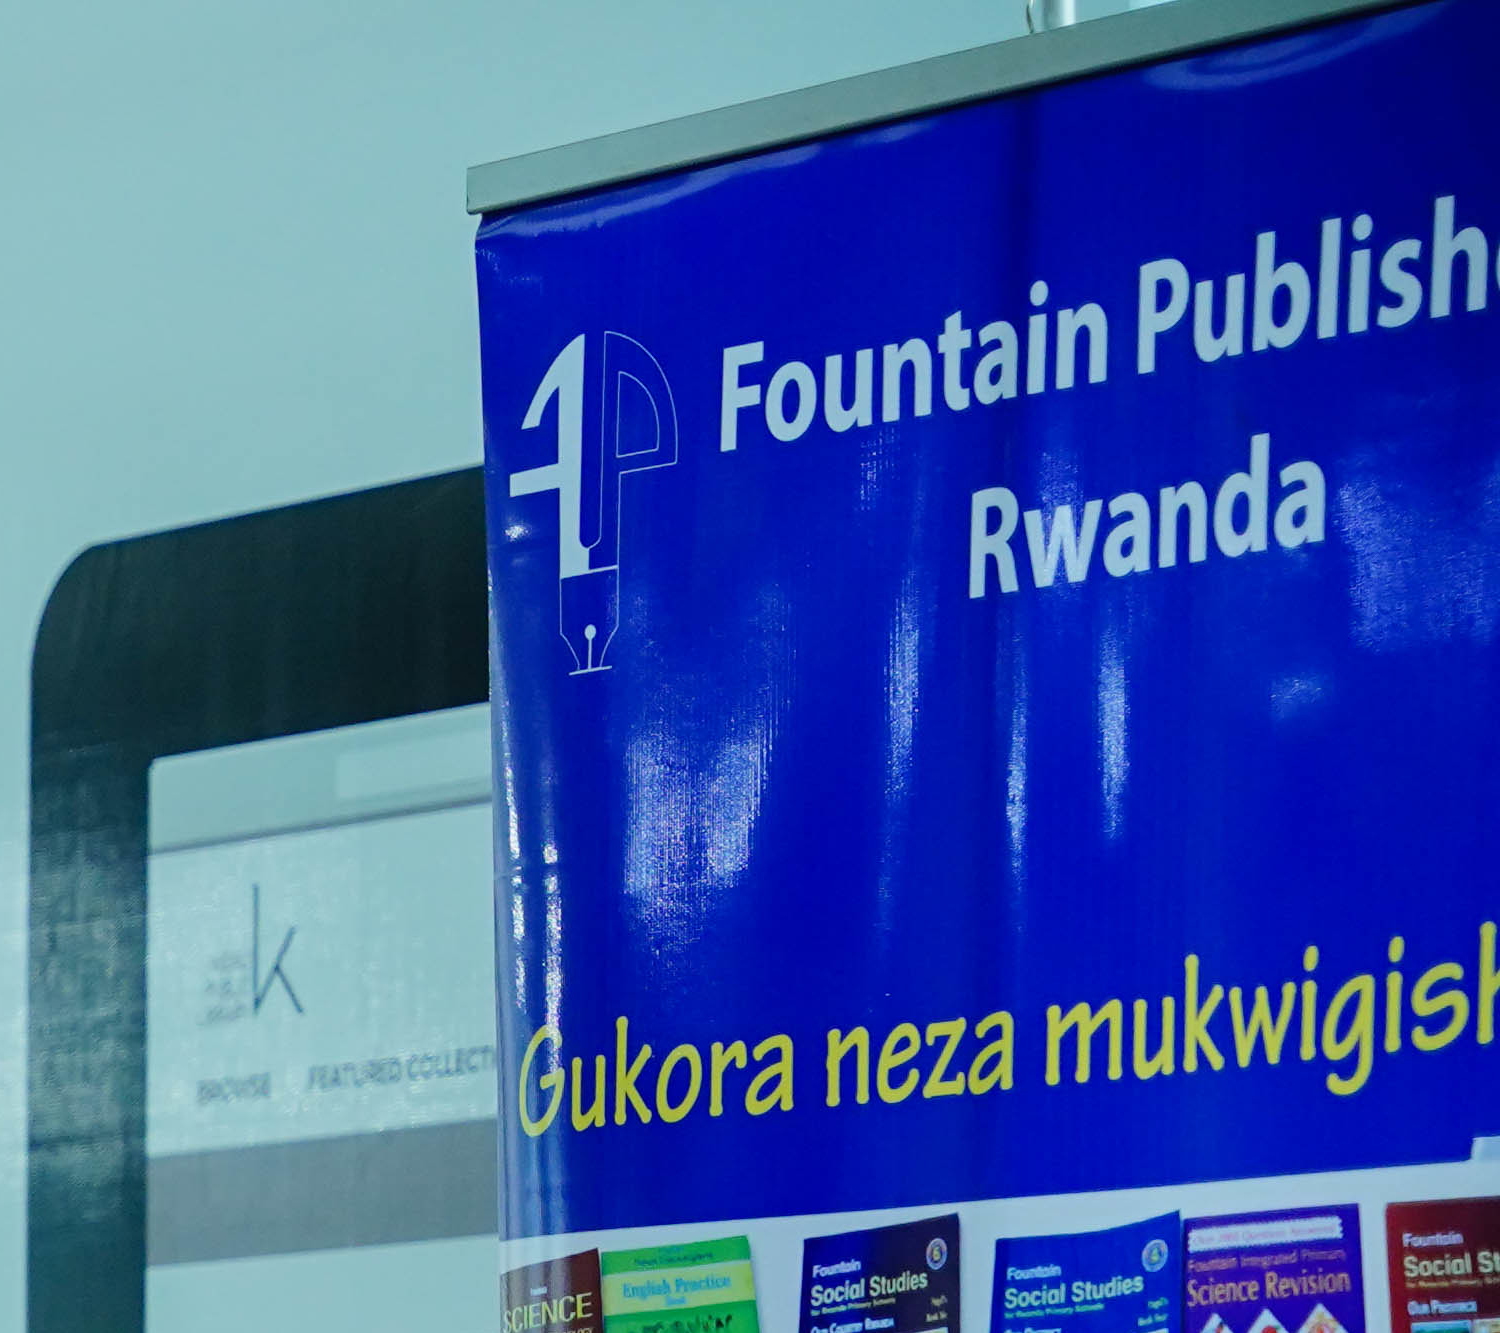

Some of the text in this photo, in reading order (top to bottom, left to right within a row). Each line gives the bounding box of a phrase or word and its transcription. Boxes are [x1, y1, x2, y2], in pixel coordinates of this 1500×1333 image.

[719, 195, 1500, 453] Fountain Publish
[968, 433, 1328, 600] Rwanda
[518, 1016, 793, 1137] Gukora
[825, 1010, 1015, 1108] neza
[812, 1259, 861, 1278] Fountain
[1006, 1264, 1062, 1281] Fountain
[1404, 1251, 1472, 1277] Social
[622, 1274, 732, 1299] English Practice
[811, 1270, 928, 1307] Social Studies
[1004, 1275, 1144, 1309] Social Studies
[1187, 1267, 1351, 1307] Science Revision
